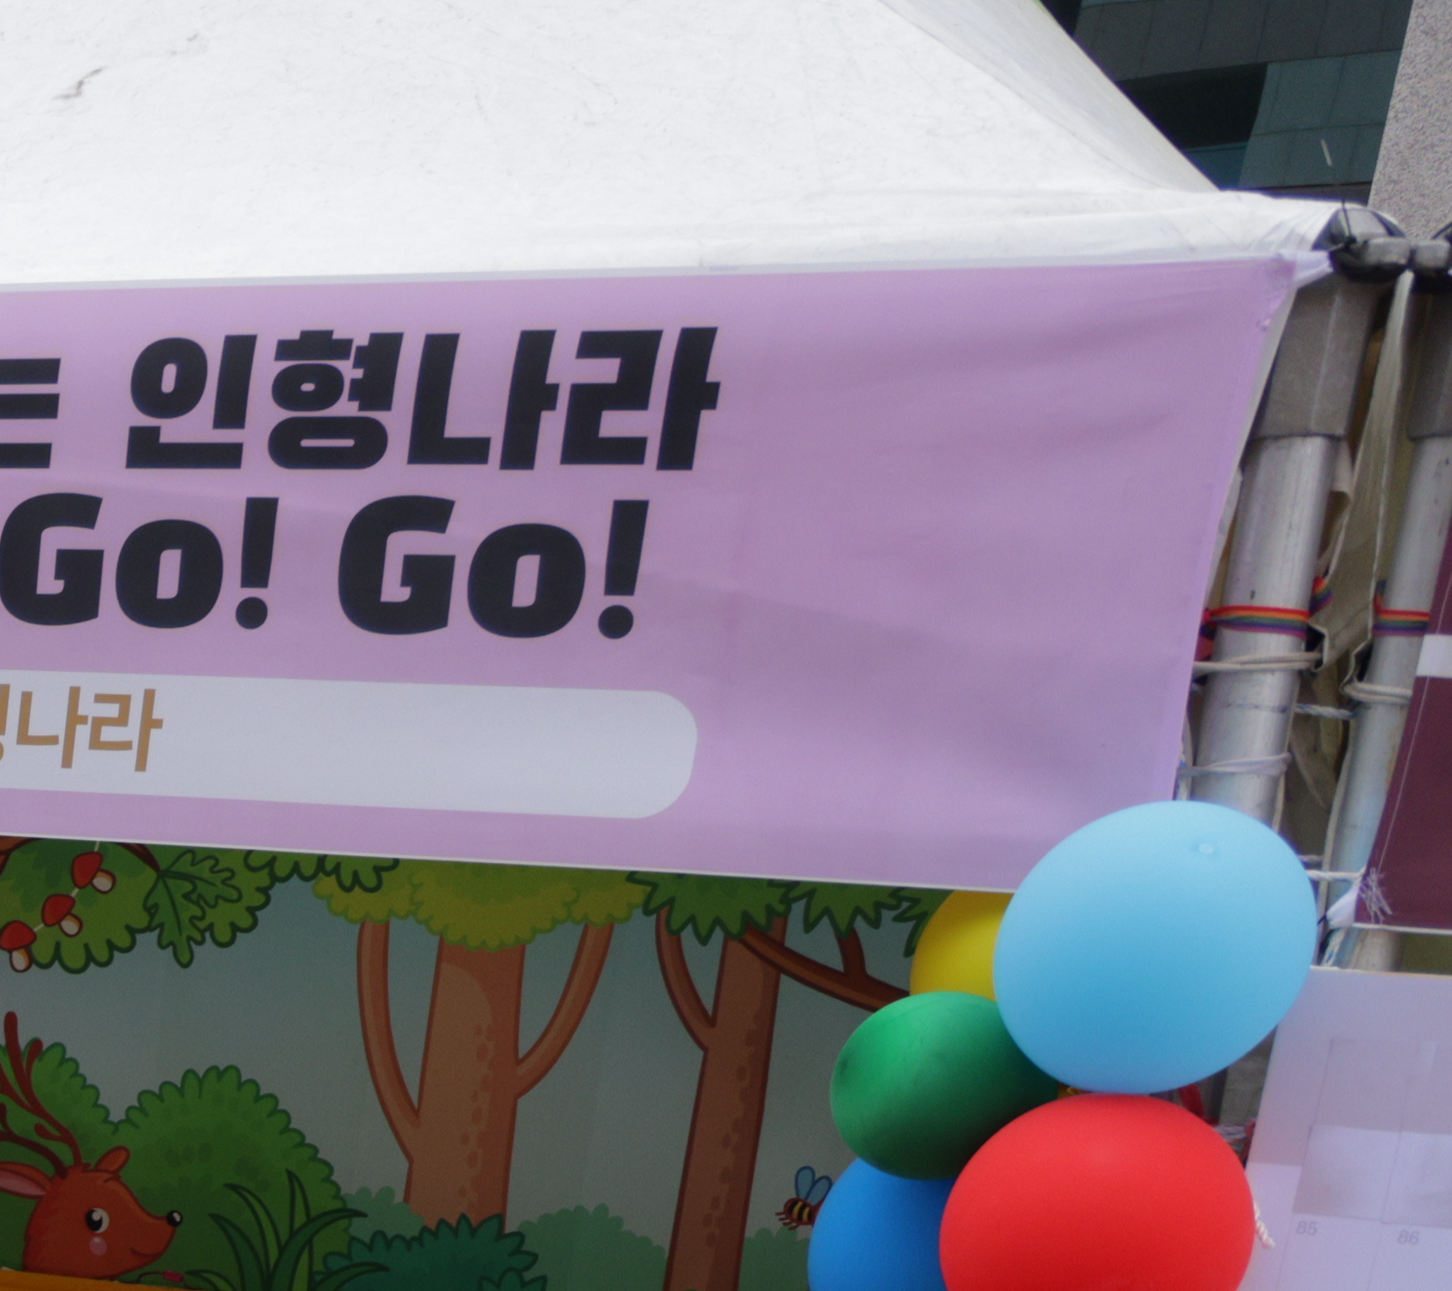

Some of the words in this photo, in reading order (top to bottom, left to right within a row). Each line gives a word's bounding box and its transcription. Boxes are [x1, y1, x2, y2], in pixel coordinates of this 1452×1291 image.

[124, 326, 722, 472] 인형나라
[337, 494, 651, 640] Go!
[1295, 1220, 1319, 1237] 85
[1396, 1229, 1421, 1246] 86
